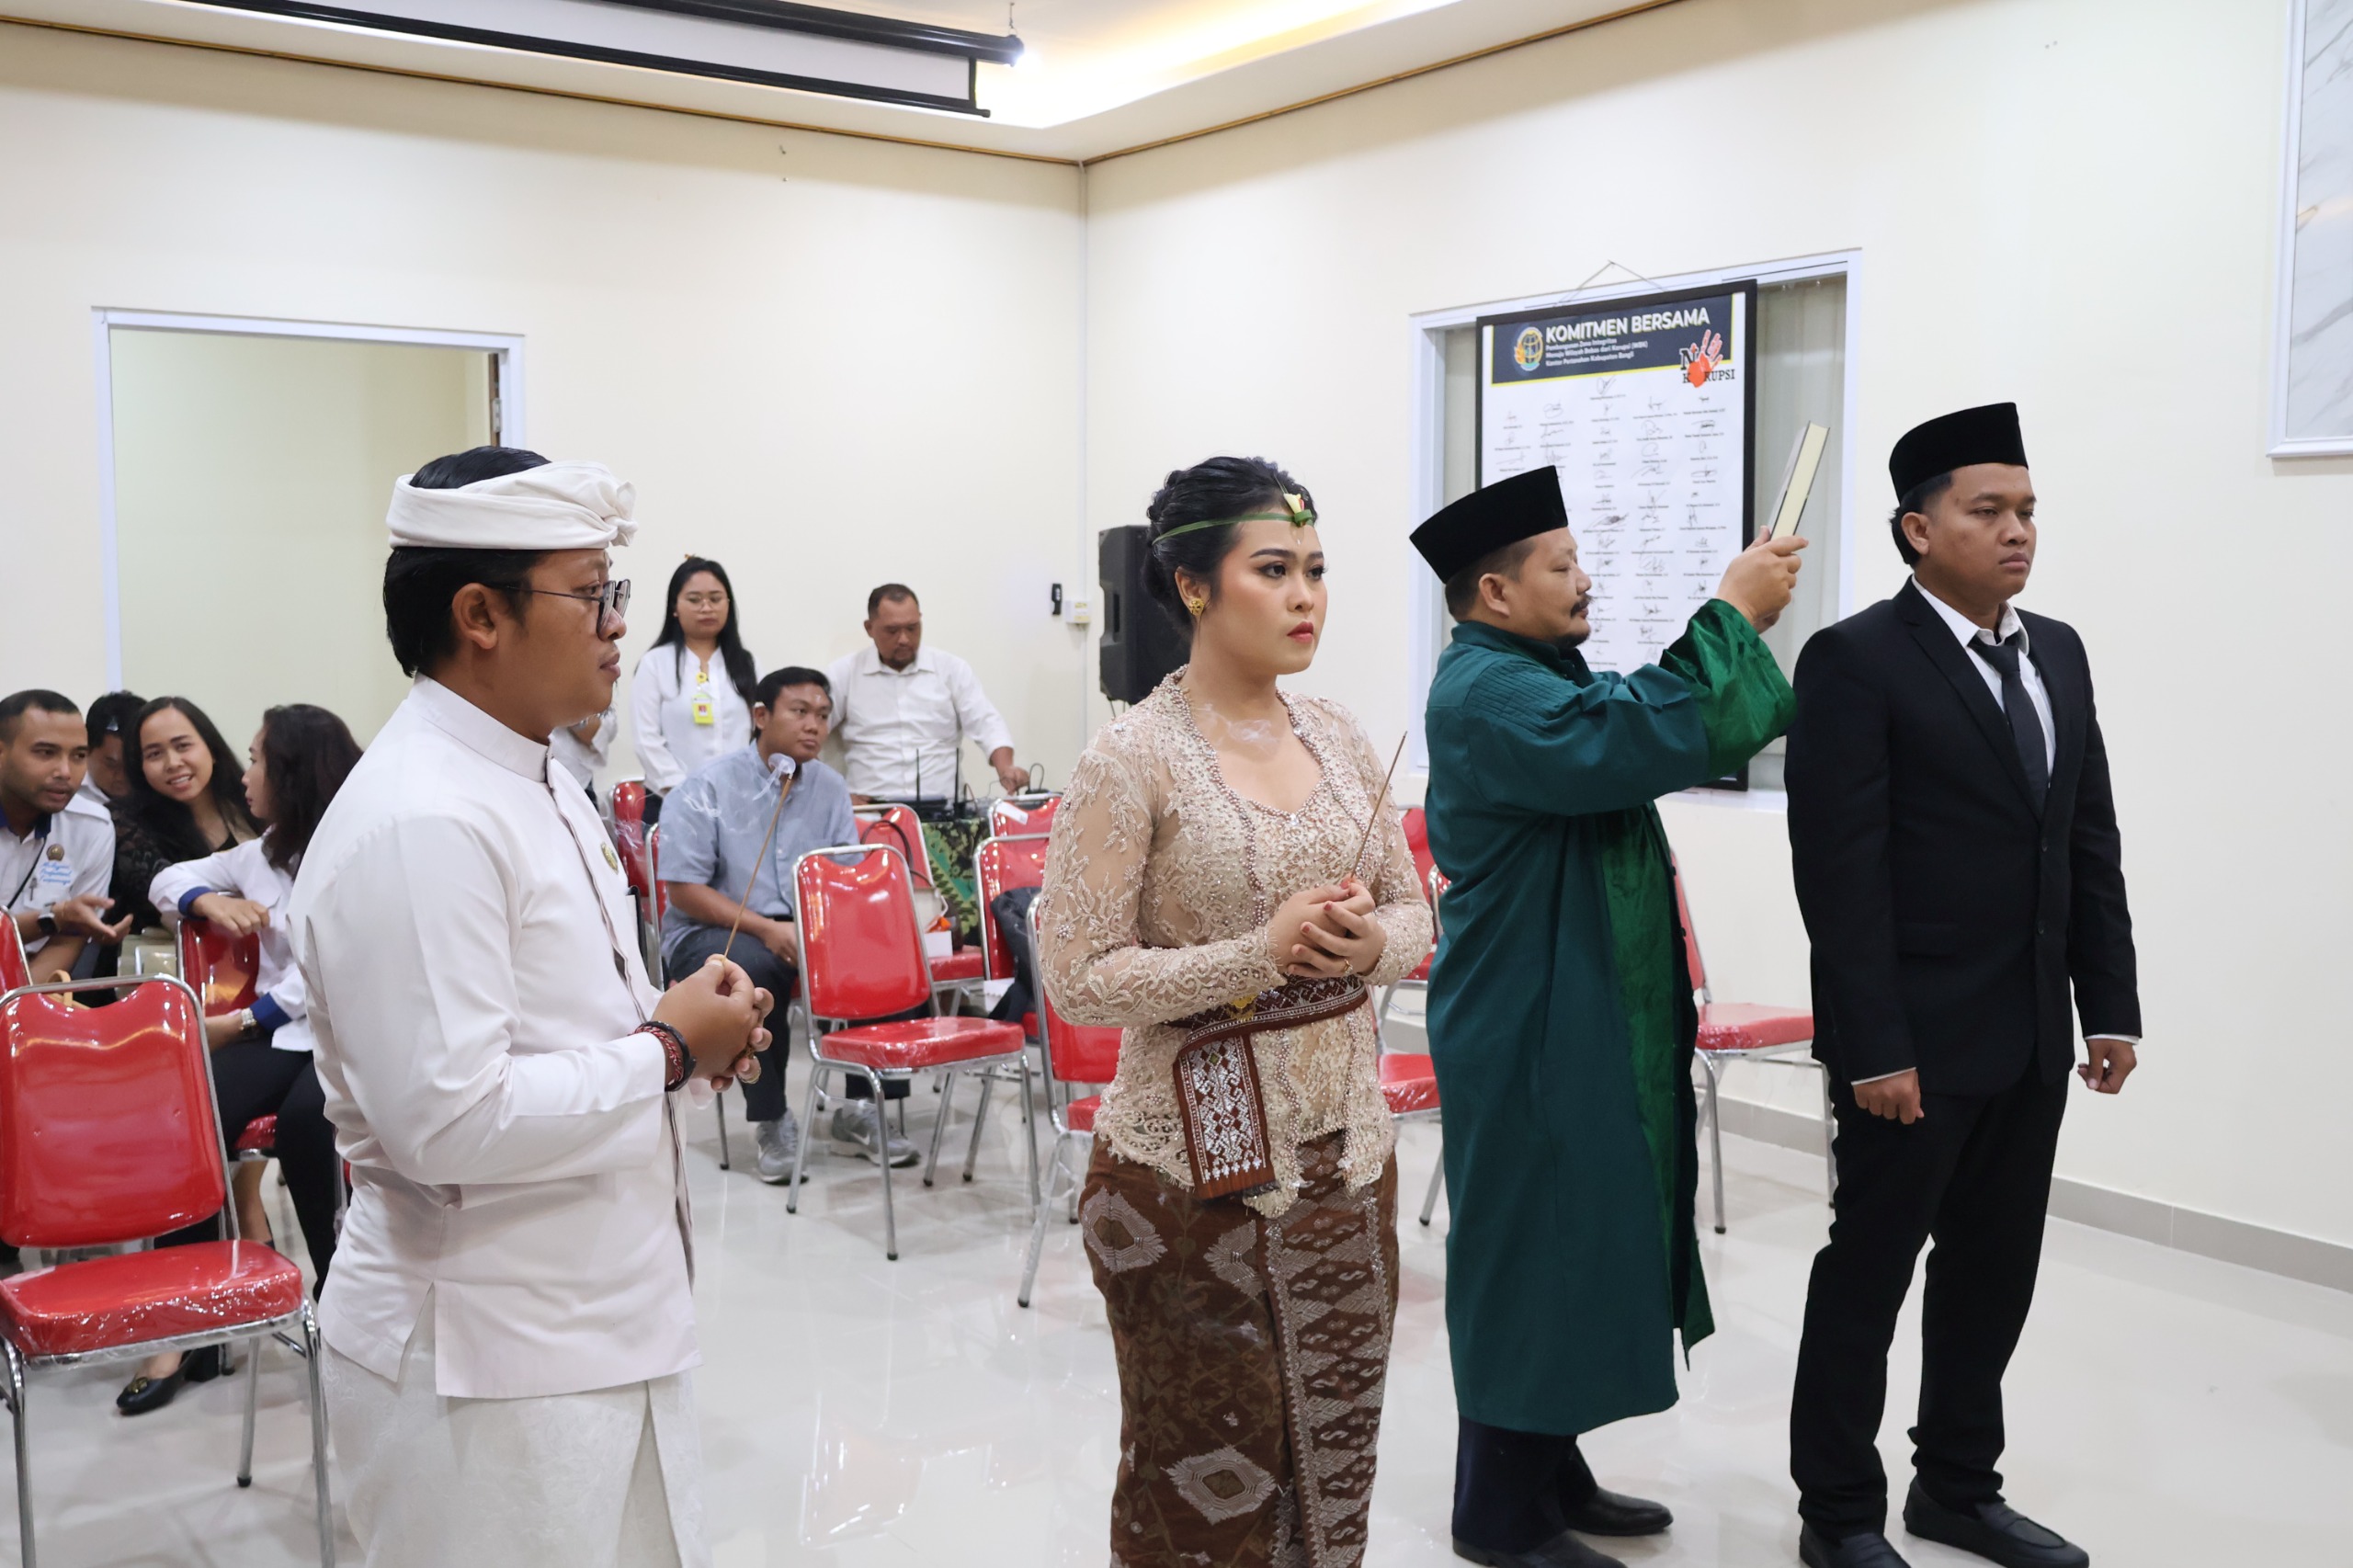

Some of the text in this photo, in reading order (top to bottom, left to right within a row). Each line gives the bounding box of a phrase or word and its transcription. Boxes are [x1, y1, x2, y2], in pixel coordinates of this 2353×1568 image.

[1545, 307, 1711, 344] KOMITMEN BERSAMA
[1682, 369, 1735, 384] KRUPSI
